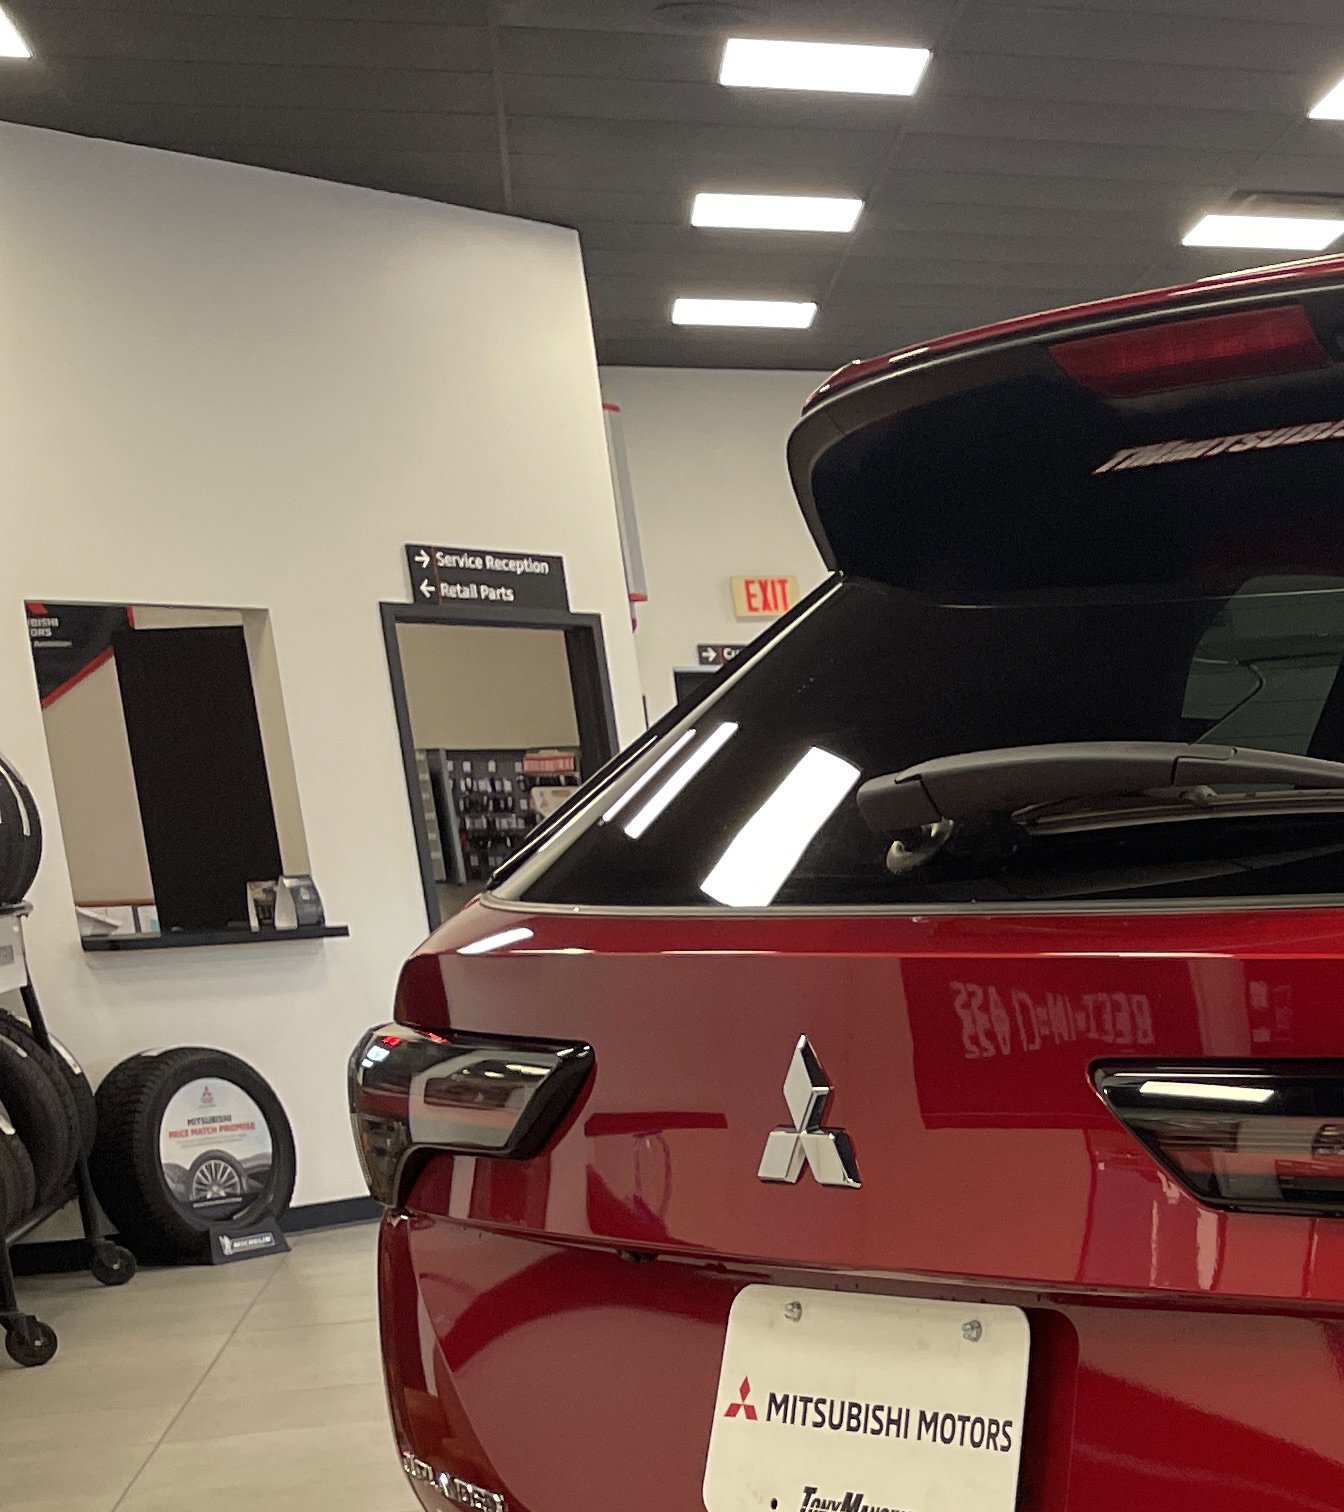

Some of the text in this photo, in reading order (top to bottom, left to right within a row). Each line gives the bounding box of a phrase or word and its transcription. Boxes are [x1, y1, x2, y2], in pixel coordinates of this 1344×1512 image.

[435, 551, 549, 575] Service Reception
[440, 582, 514, 602] Retail Parts
[744, 578, 788, 613] EXIT
[187, 1114, 232, 1127] MITSUBISHI
[190, 1126, 218, 1137] MATCH
[766, 1392, 1013, 1452] MITSUBISHI MOTORS
